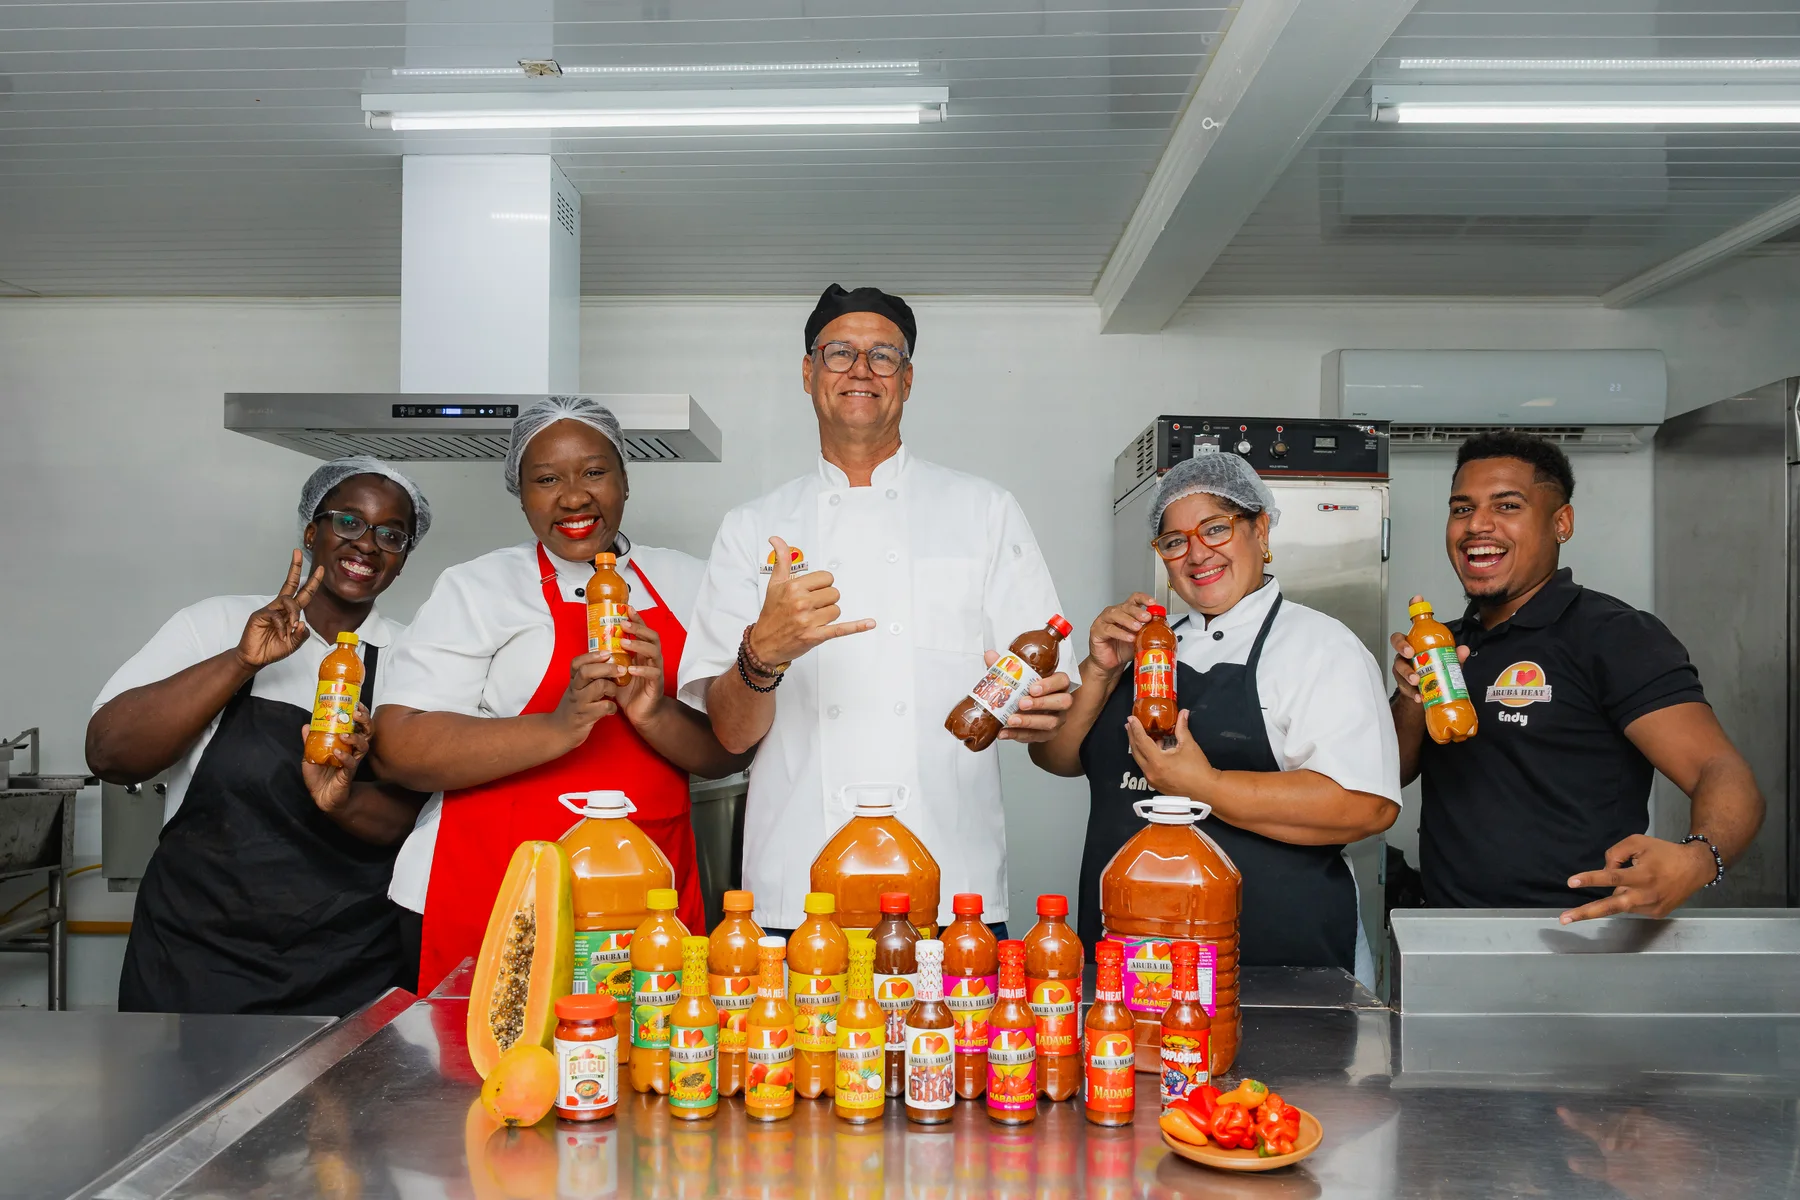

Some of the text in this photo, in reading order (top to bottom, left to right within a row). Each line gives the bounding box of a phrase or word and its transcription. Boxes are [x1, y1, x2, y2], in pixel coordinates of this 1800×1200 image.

[1509, 669, 1519, 686] I
[1491, 689, 1545, 697] ARUBA HEAT
[1498, 711, 1528, 726] Endy
[609, 933, 617, 950] I
[1145, 942, 1154, 959] I
[595, 953, 622, 962] ARUBA
[1130, 961, 1158, 970] ARUBA
[650, 974, 659, 992] I
[724, 977, 733, 996] I
[810, 979, 818, 994] I
[960, 978, 970, 997] I
[598, 987, 631, 996] PAPAY
[885, 981, 893, 999] I
[1043, 987, 1050, 1004] I
[1105, 991, 1122, 1001] HEAT
[1171, 988, 1183, 1000] EAT
[638, 993, 680, 1003] ARUBA HEA
[712, 998, 737, 1007] ARUBA
[798, 995, 839, 1004] ARUBA HEAT
[948, 997, 994, 1008] ARUBA HEAT
[1131, 997, 1172, 1008] HABANE
[1031, 1004, 1072, 1013] ARUBA HEAT
[640, 1032, 670, 1043] PAPA
[677, 1028, 686, 1048] I
[762, 1029, 772, 1049] I
[848, 1032, 857, 1049] I
[954, 1038, 989, 1048] ABANER
[1000, 1030, 1010, 1050] I
[918, 1035, 927, 1055] I
[1105, 1041, 1115, 1057] I
[670, 1050, 689, 1060] RUBA
[749, 1051, 775, 1060] ARUBA
[839, 1048, 880, 1060] ARUBA HEAT
[911, 1054, 952, 1065] ARUBA HEAT
[988, 1050, 1035, 1061] ARUBA HEAT
[569, 1059, 606, 1075] RUCU
[1093, 1058, 1118, 1066] ARUA
[989, 1091, 1035, 1104] HABANERO
[1093, 1085, 1133, 1099] MADAME
